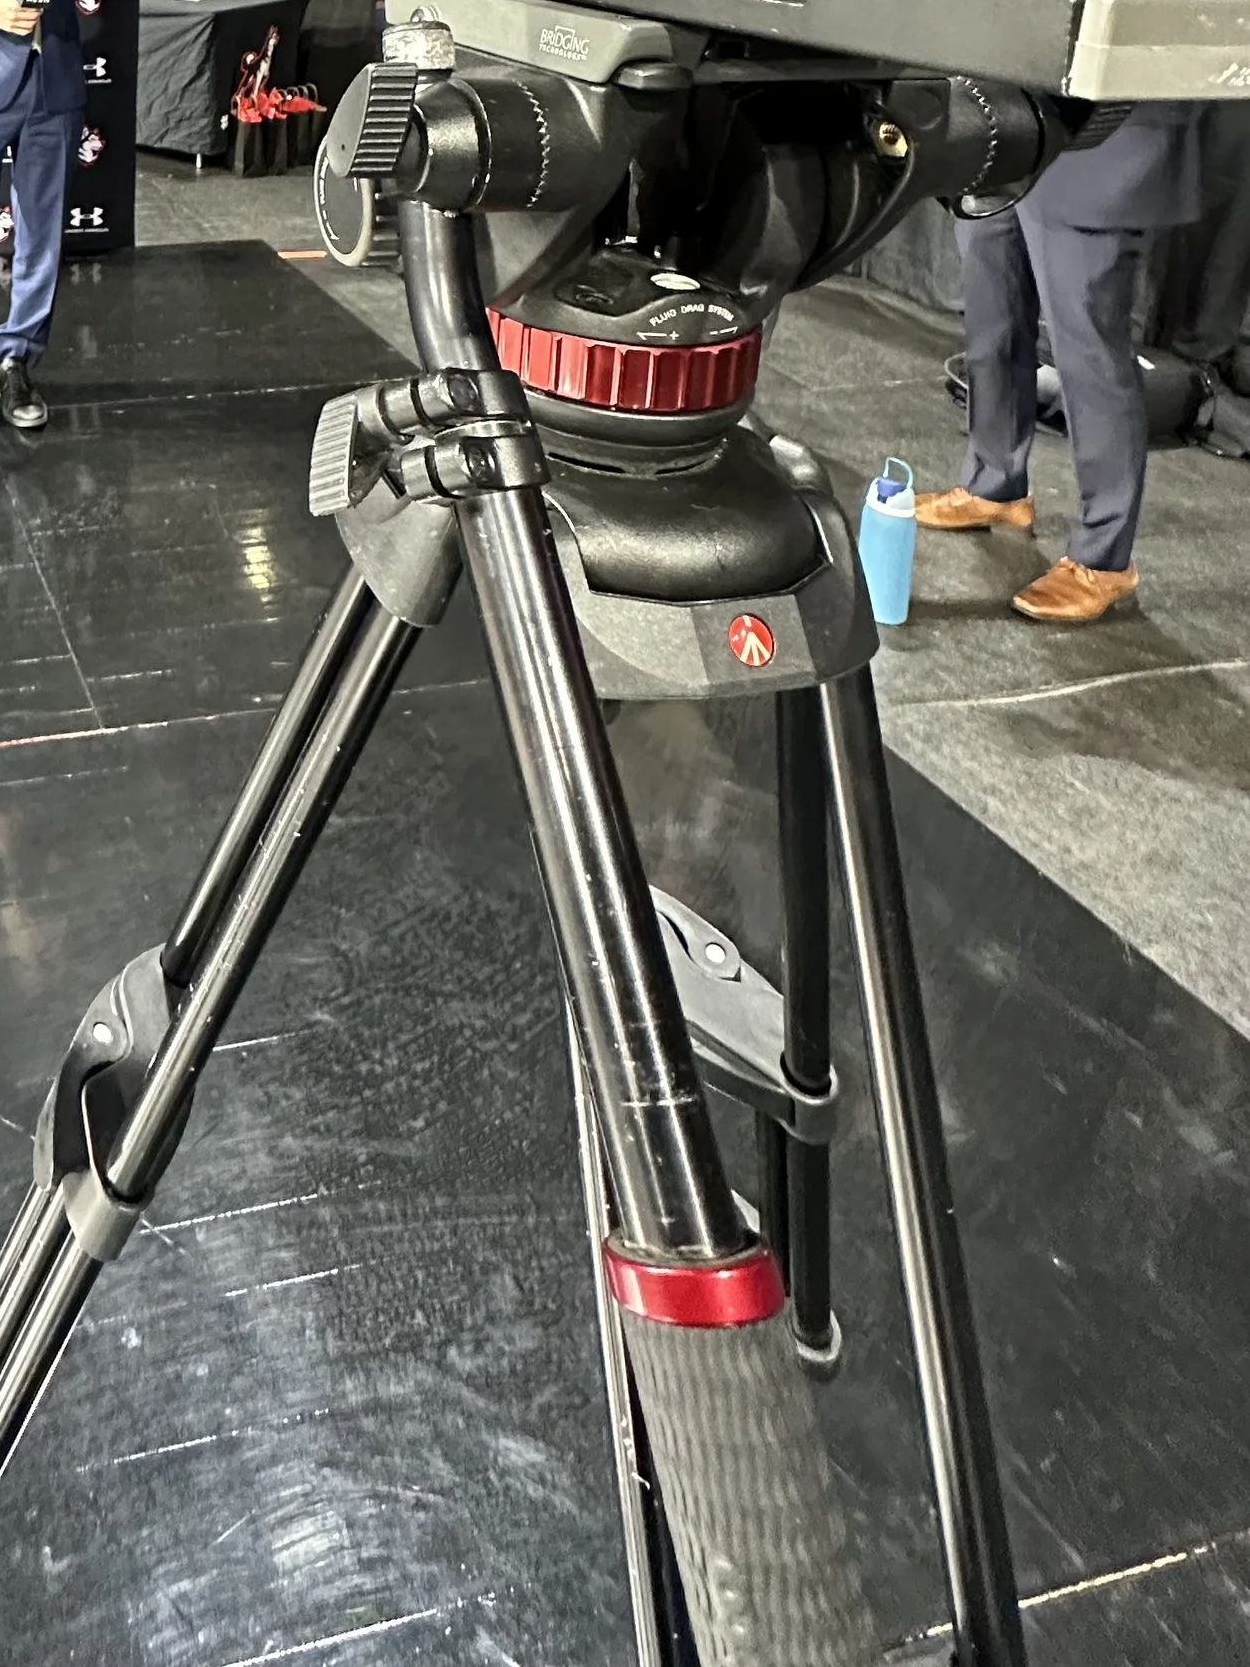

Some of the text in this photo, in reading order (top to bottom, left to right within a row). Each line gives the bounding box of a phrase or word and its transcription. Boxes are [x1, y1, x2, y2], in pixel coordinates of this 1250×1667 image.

[540, 26, 591, 55] BRIDGING
[649, 309, 677, 327] FLUID
[681, 303, 705, 314] DRAG
